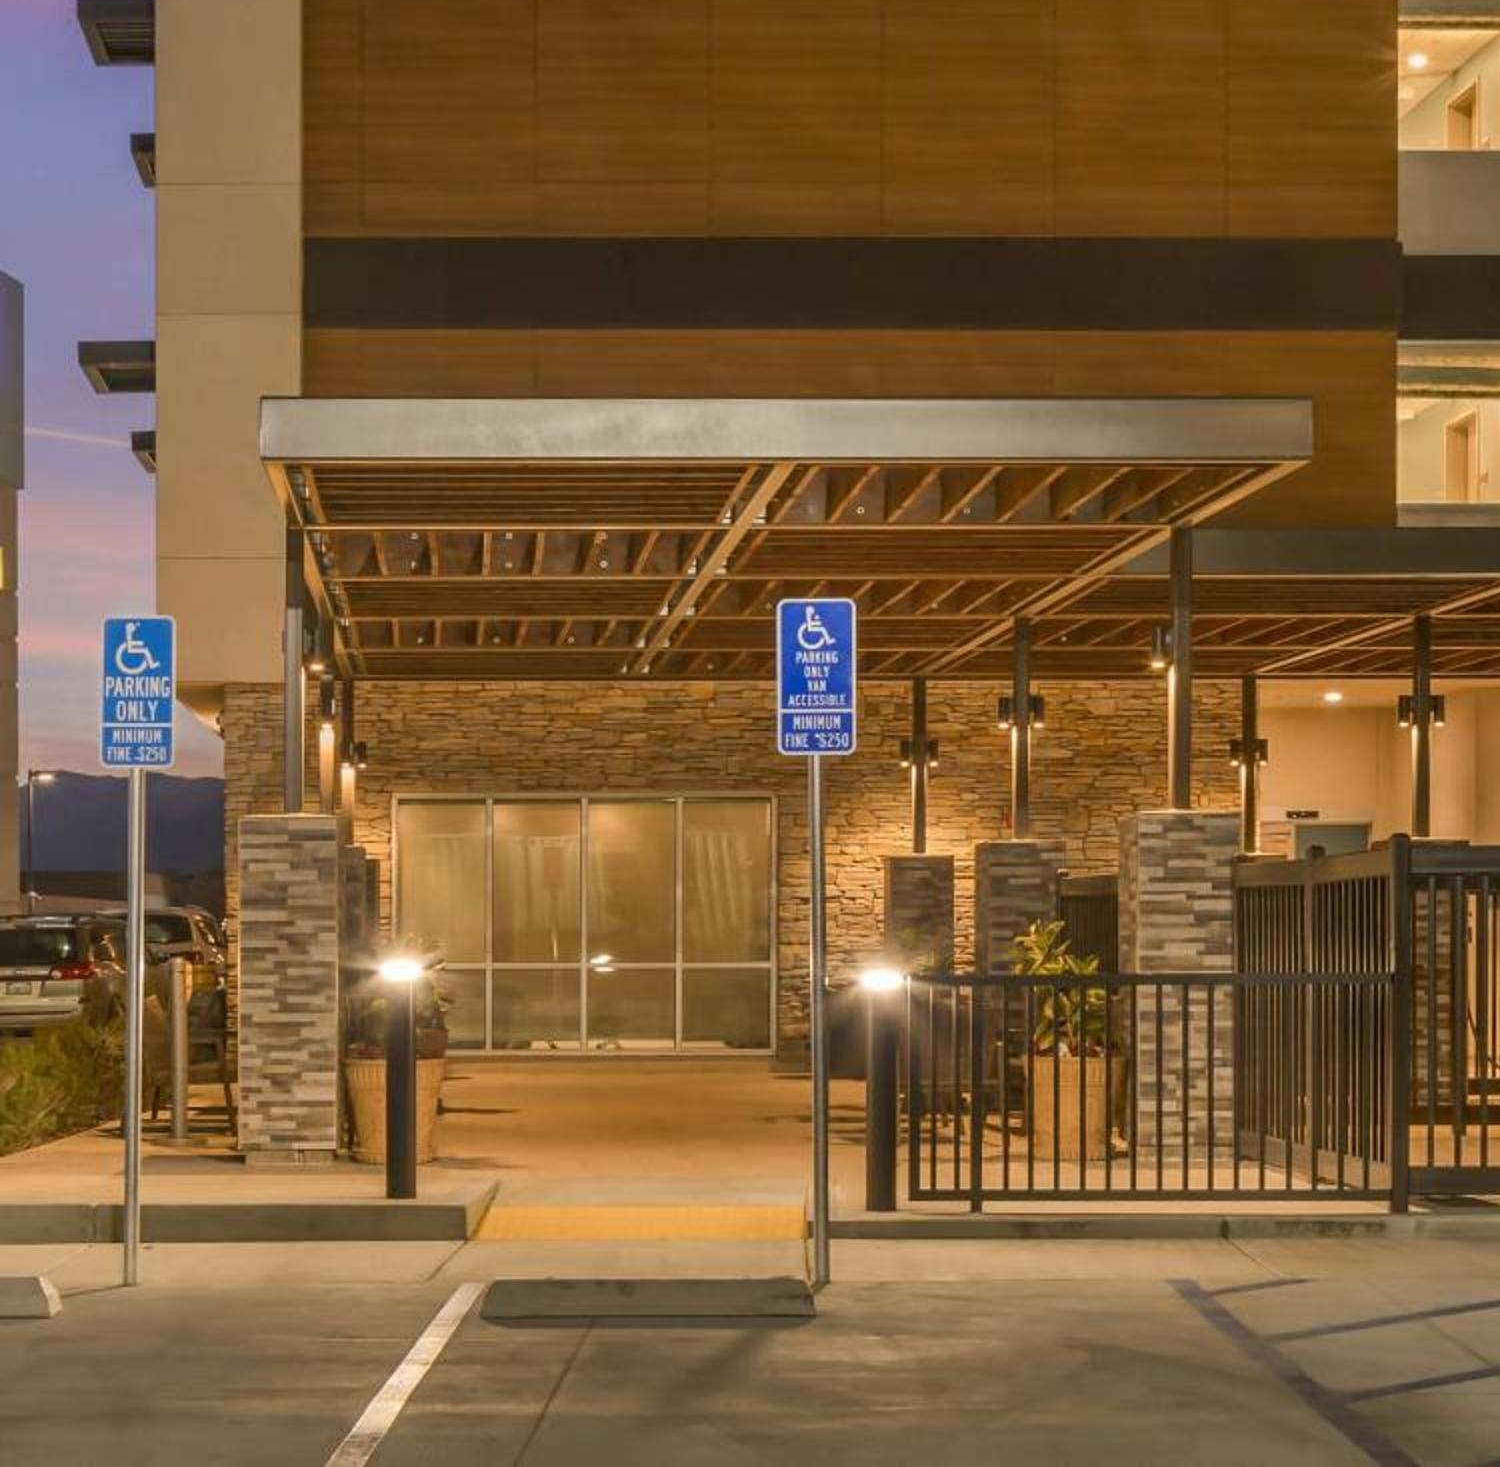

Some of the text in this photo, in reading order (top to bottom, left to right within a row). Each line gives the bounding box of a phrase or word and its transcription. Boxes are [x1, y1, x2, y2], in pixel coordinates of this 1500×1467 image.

[795, 651, 839, 664] PARKING
[804, 665, 830, 678] ONLY
[105, 677, 171, 698] PARKING
[807, 680, 827, 691] VAN
[788, 694, 846, 707] ACCESSIBLE
[115, 700, 159, 721] ONLY
[793, 714, 841, 730] MINIMUM
[112, 728, 162, 743] MINIMUM
[785, 732, 849, 748] FINE $250
[107, 746, 167, 762] FINE $250
